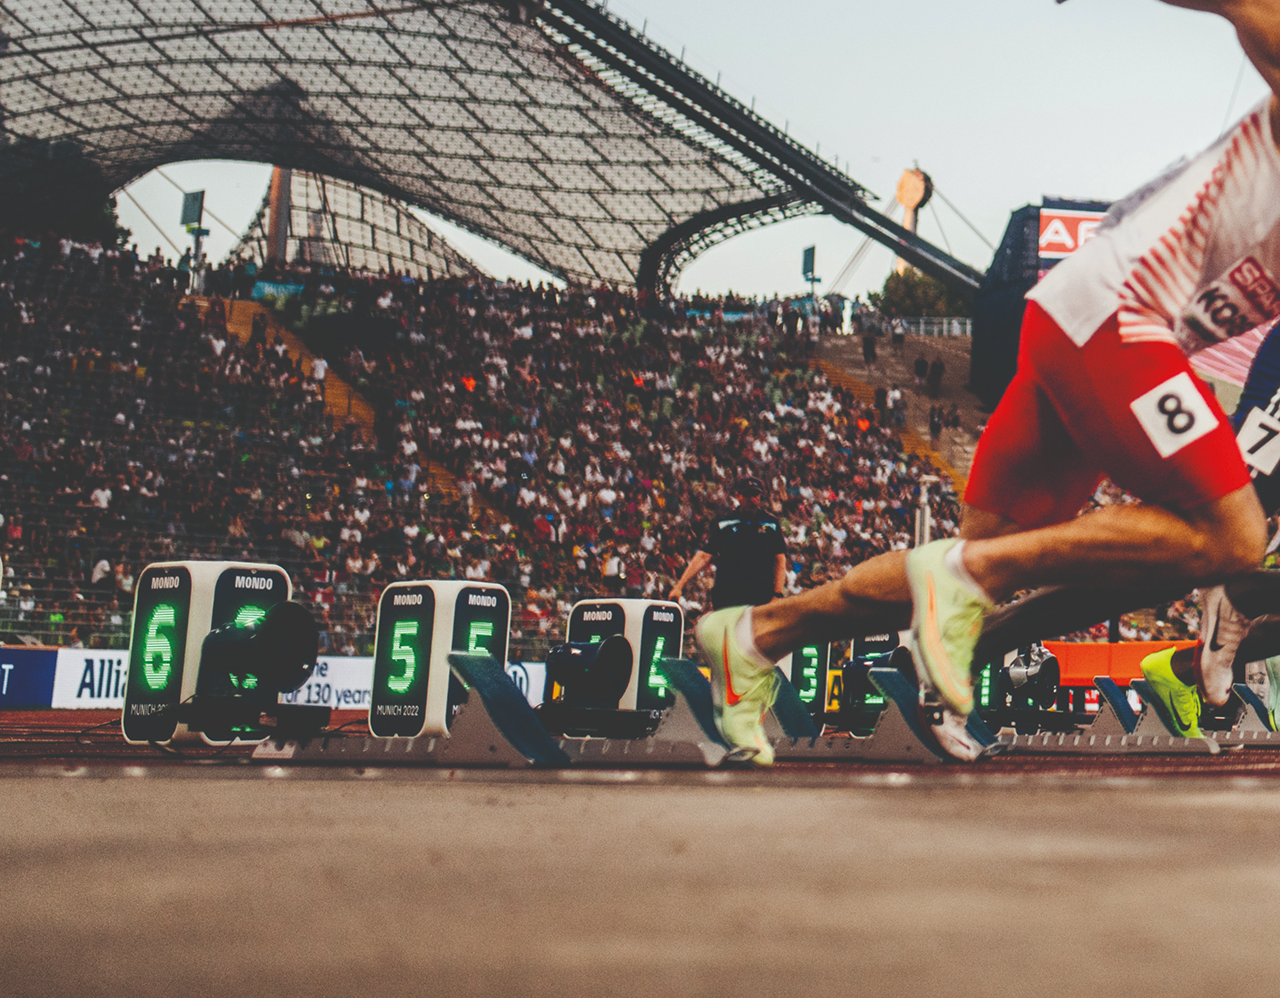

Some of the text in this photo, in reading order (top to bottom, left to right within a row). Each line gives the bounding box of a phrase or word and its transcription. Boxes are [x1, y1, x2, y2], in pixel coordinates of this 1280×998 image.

[1157, 393, 1195, 434] 8
[1247, 422, 1280, 455] 7
[151, 576, 180, 590] MONDO
[235, 576, 273, 590] MONDO
[393, 594, 423, 606] MONDO
[468, 594, 497, 608] MONDO
[583, 611, 613, 622] MONDO
[652, 611, 675, 623] MONDO
[143, 604, 176, 690] 6
[387, 620, 419, 694] 5
[799, 646, 818, 703] 3
[305, 683, 331, 704] 130
[376, 705, 419, 717] MUNICH 2022
